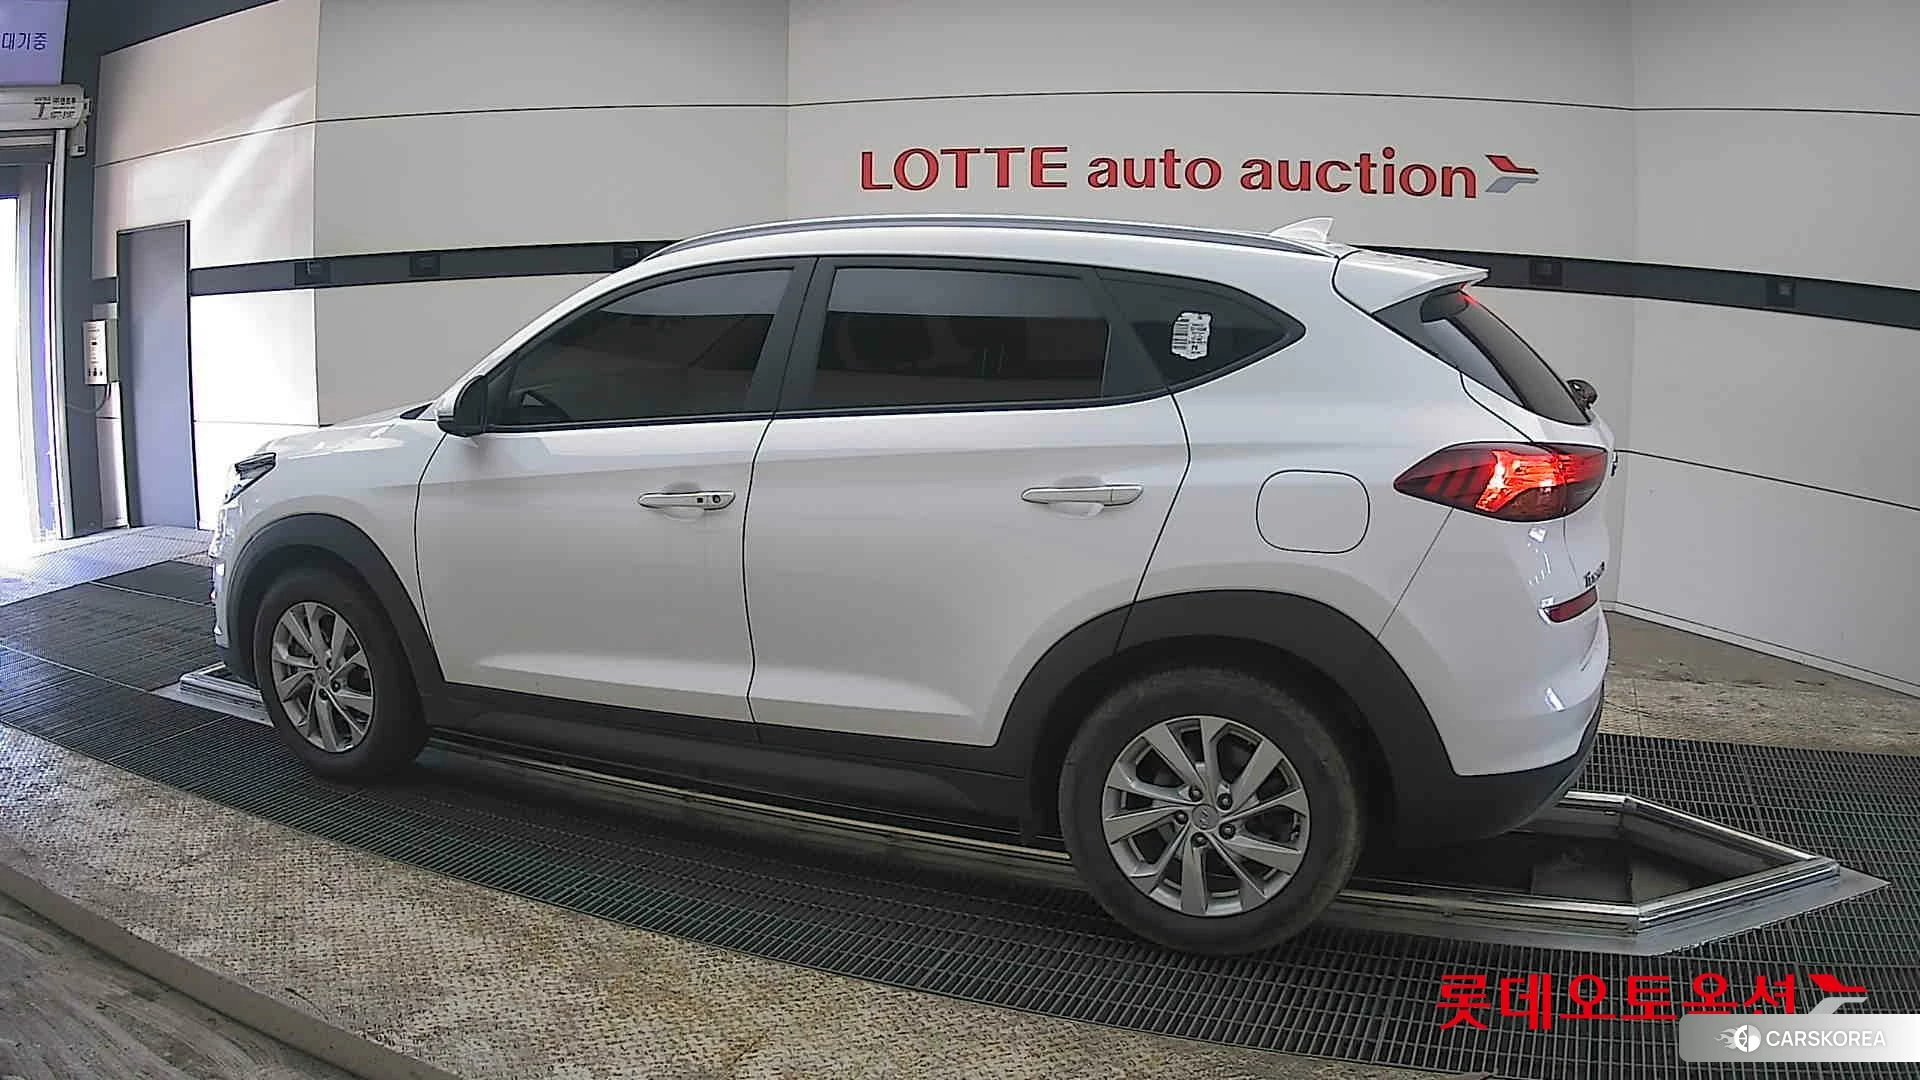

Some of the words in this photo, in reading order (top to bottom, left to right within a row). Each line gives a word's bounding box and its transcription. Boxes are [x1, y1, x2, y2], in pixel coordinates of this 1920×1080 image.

[861, 146, 1068, 191] LOTTE
[1087, 148, 1222, 190] auto
[1239, 146, 1477, 199] auction
